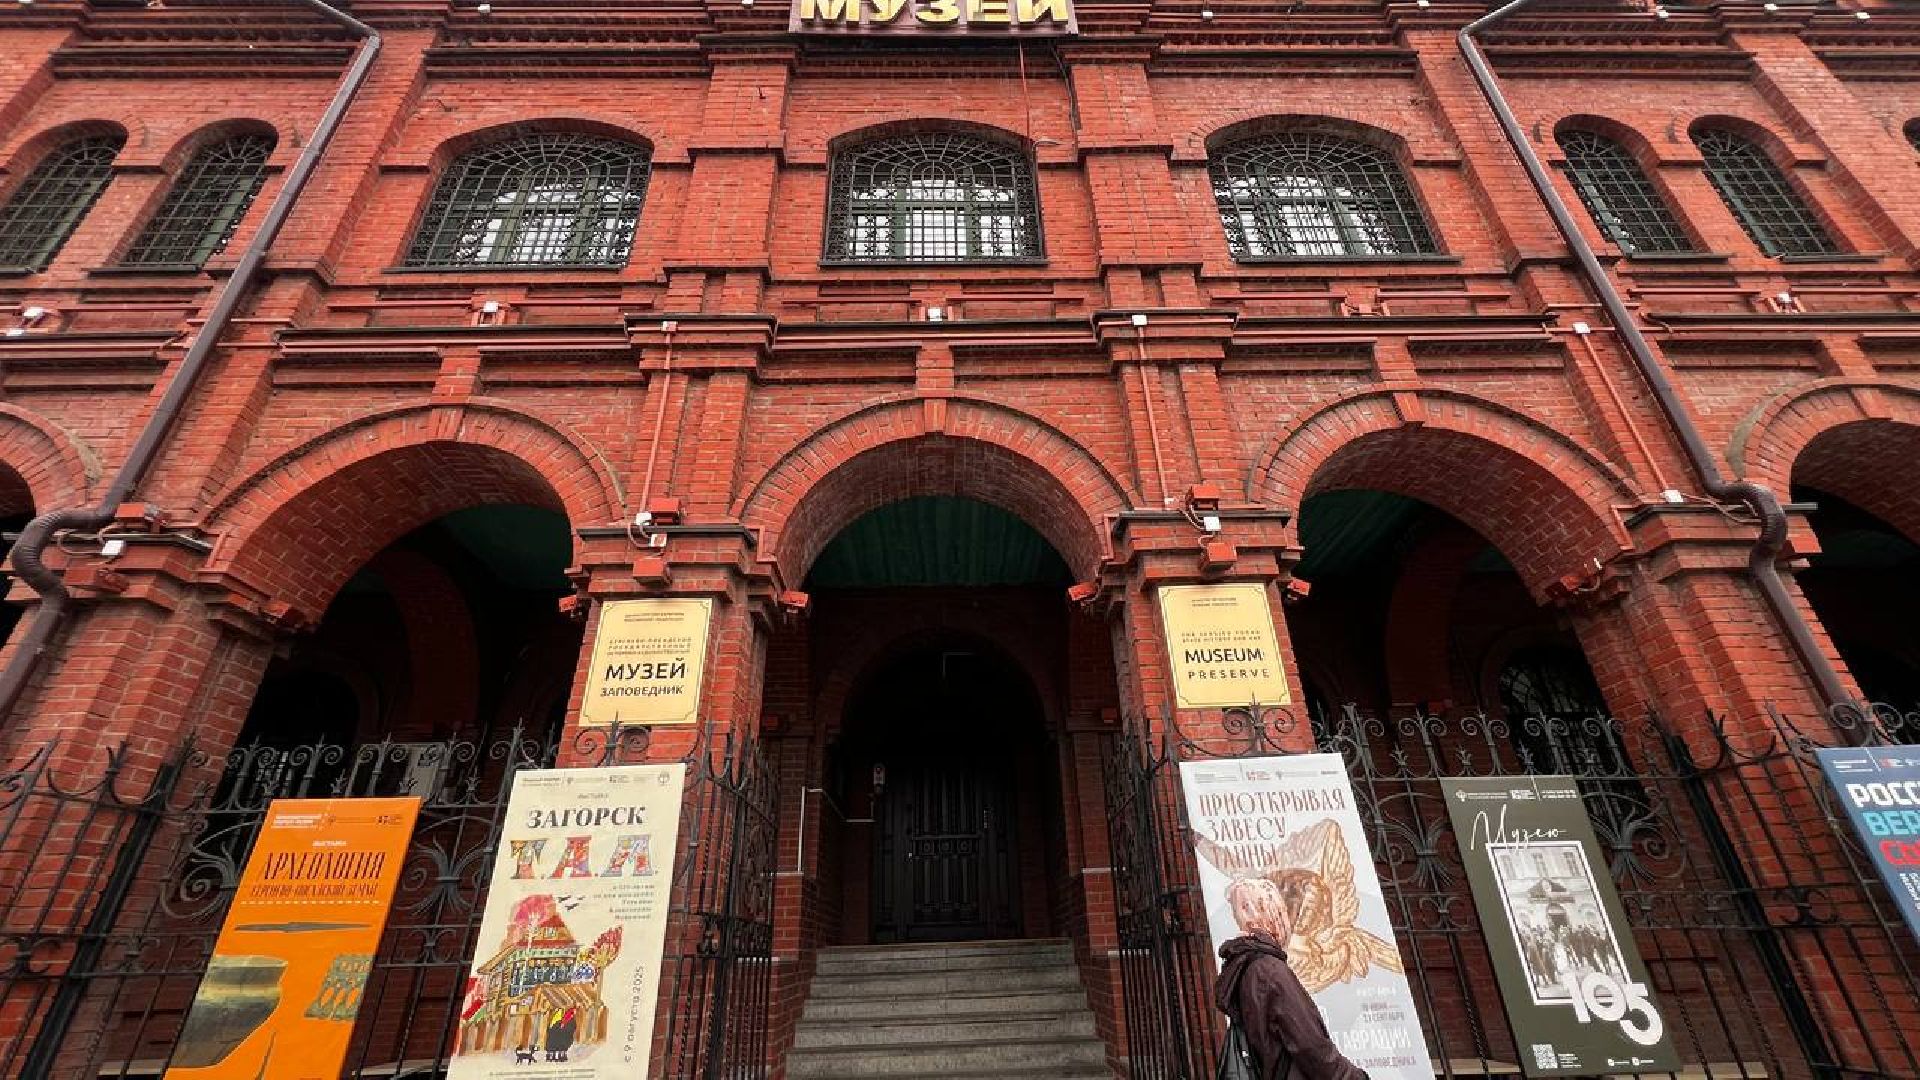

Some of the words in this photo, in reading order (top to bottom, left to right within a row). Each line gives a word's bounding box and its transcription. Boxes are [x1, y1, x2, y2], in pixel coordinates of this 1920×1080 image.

[1185, 647, 1264, 664] MUSEUM
[605, 657, 686, 681] МУЗЕЙ
[1188, 669, 1270, 680] PRESERVE
[600, 684, 684, 697] ЗАПОВЕДНИК
[1199, 788, 1346, 817] ПРИОТКРЫВАЯ
[528, 806, 646, 829] ЗАГОРСК
[1206, 816, 1287, 842] ЗАВЕСУ
[1562, 969, 1663, 1046] 105
